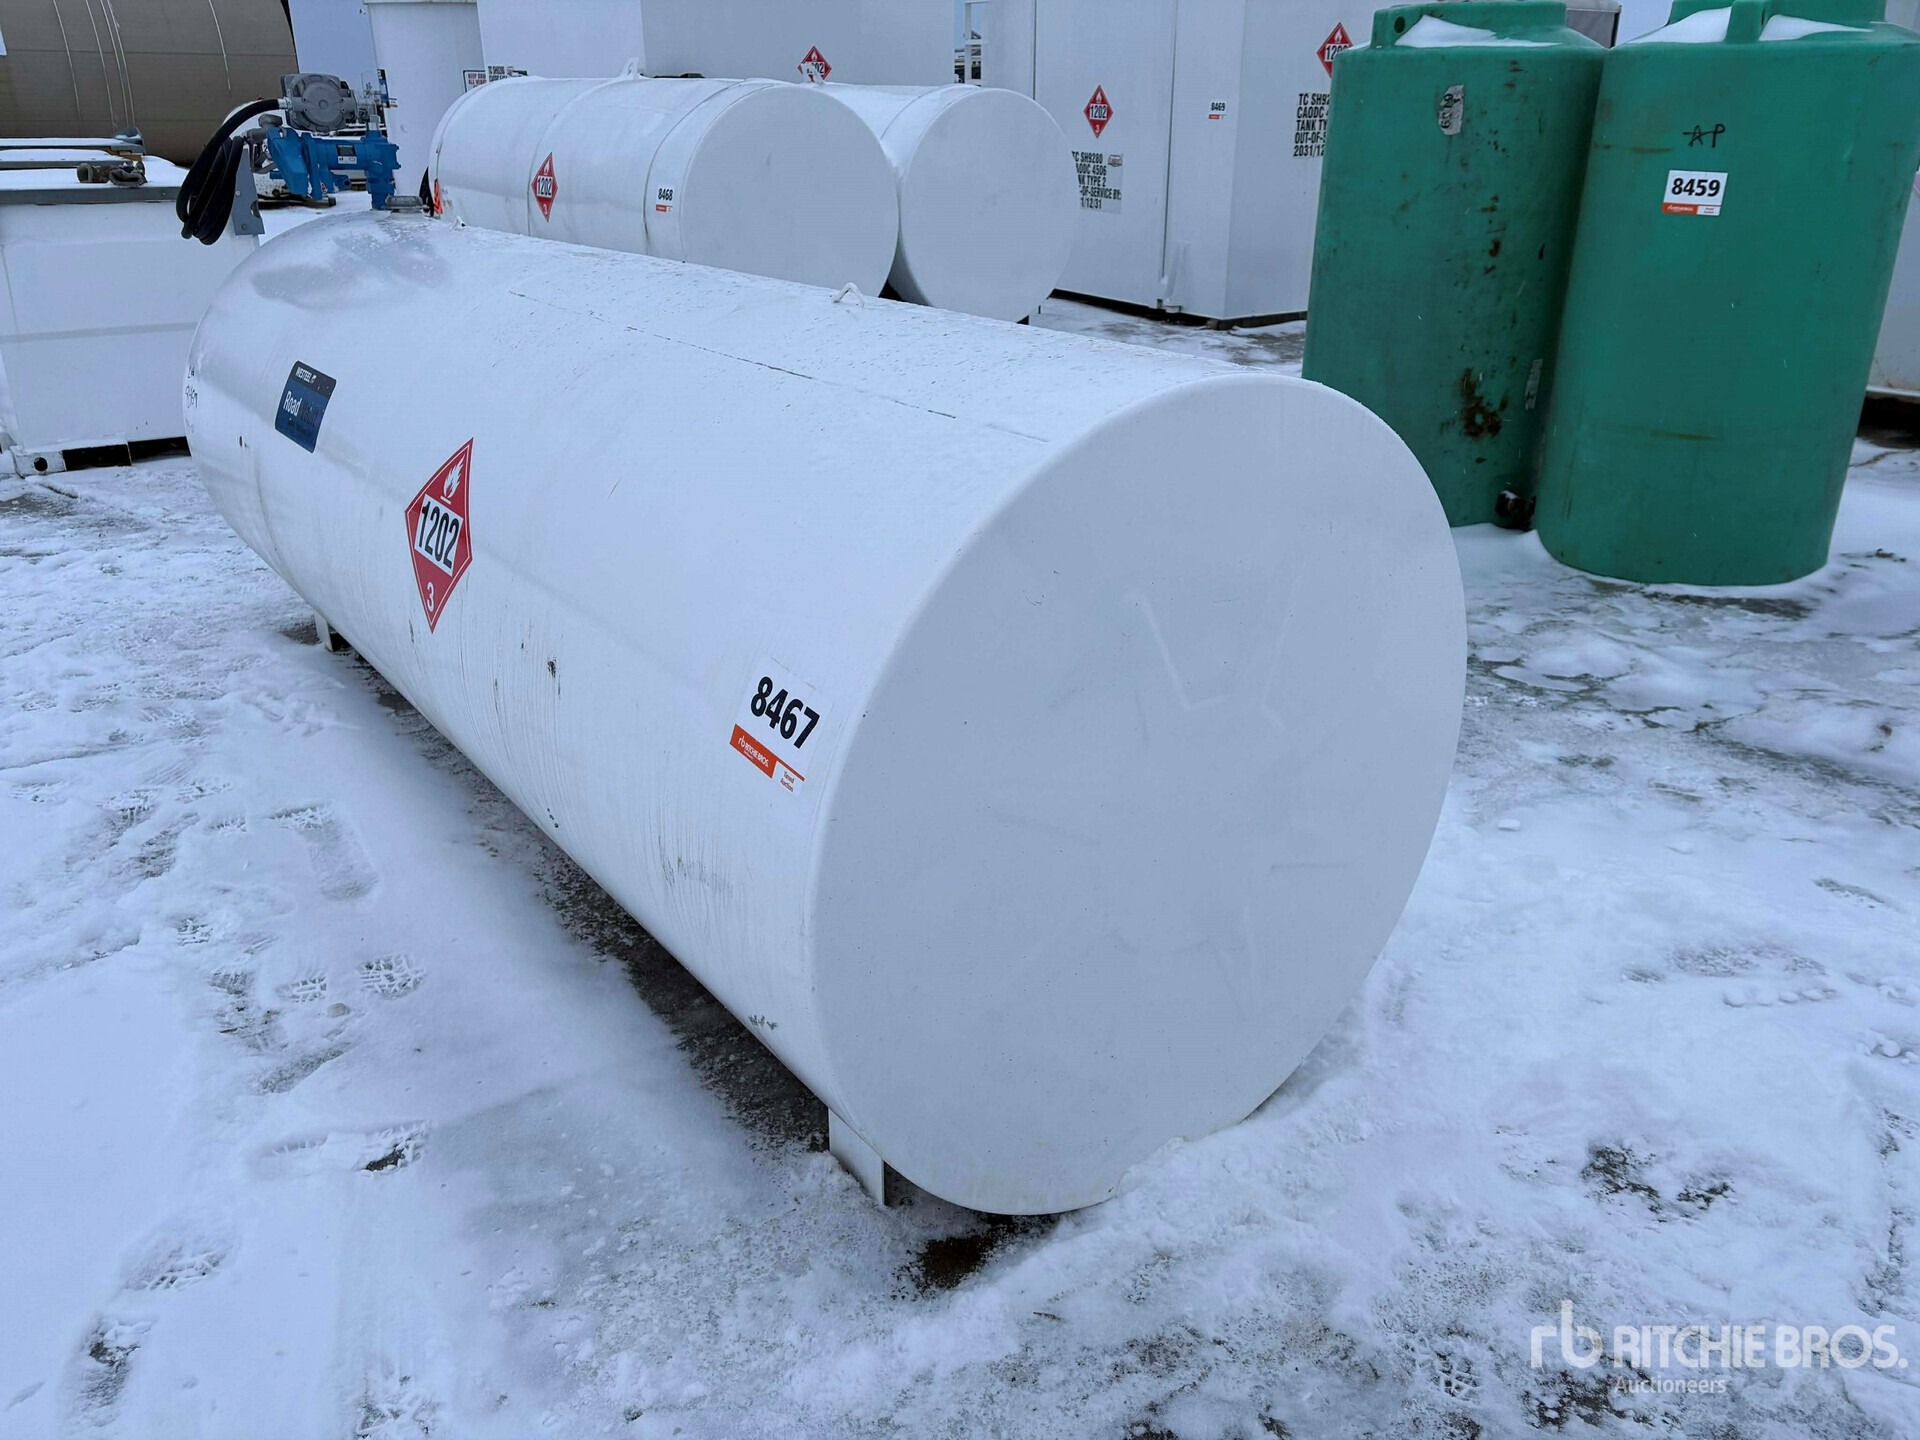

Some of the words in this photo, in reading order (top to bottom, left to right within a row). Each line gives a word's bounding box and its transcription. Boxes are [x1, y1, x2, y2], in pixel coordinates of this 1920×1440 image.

[1299, 93, 1309, 105] TC
[1311, 93, 1330, 105] SH92
[1090, 104, 1107, 119] 1202
[1297, 106, 1325, 119] CAODC
[1296, 119, 1316, 131] TANK
[1318, 119, 1328, 131] TY
[1293, 145, 1325, 157] 2031/12
[1080, 152, 1103, 164] SH9280
[1092, 165, 1107, 176] 4506
[538, 177, 552, 196] 1202
[1087, 175, 1101, 187] TYPE
[1102, 177, 1107, 187] 2
[1671, 178, 1721, 197] 8459
[658, 188, 674, 201] 8468
[283, 390, 302, 417] Road
[419, 501, 460, 570] 1202
[426, 581, 435, 613] 3
[751, 676, 820, 749] 8467
